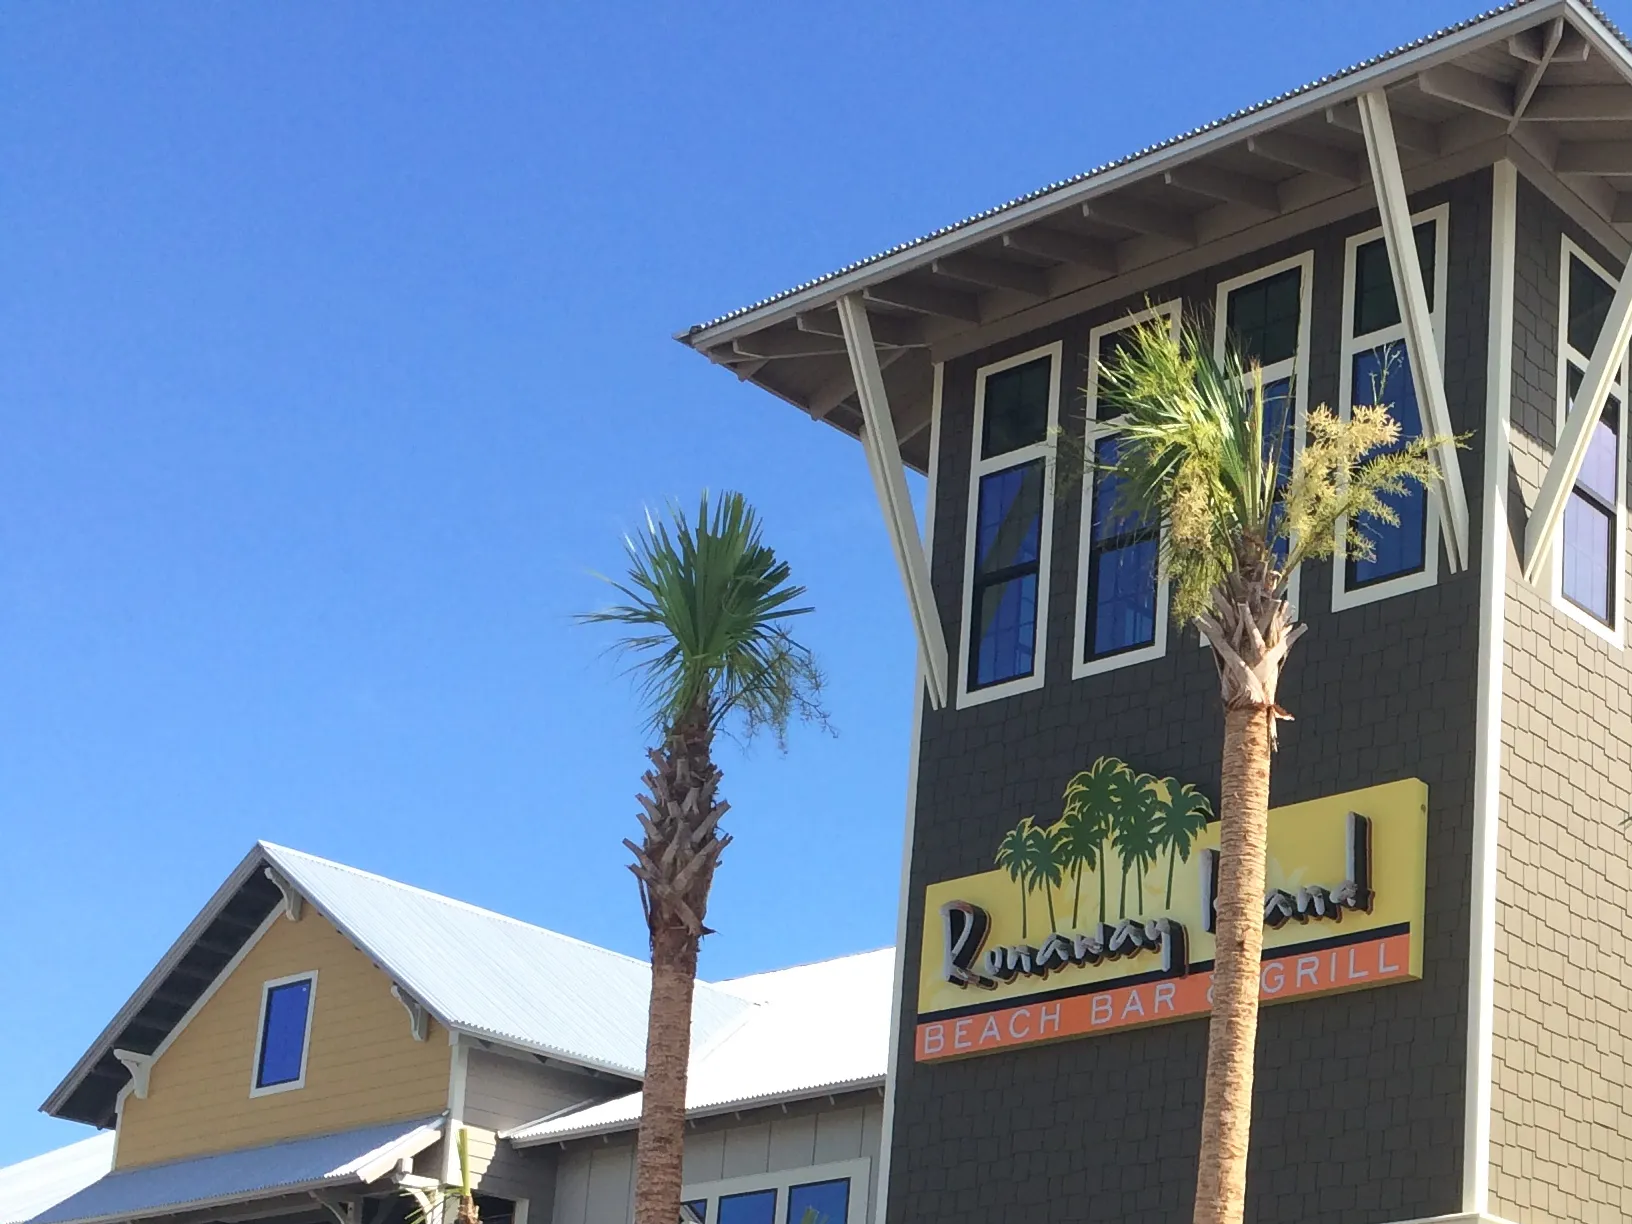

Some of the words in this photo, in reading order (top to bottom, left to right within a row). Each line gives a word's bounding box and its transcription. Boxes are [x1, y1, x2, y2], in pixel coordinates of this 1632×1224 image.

[940, 899, 1189, 991] Runaway
[1200, 811, 1375, 933] Iand
[923, 1003, 1062, 1055] BEACH
[1091, 983, 1175, 1026] BAR
[1261, 942, 1399, 993] GRILL
